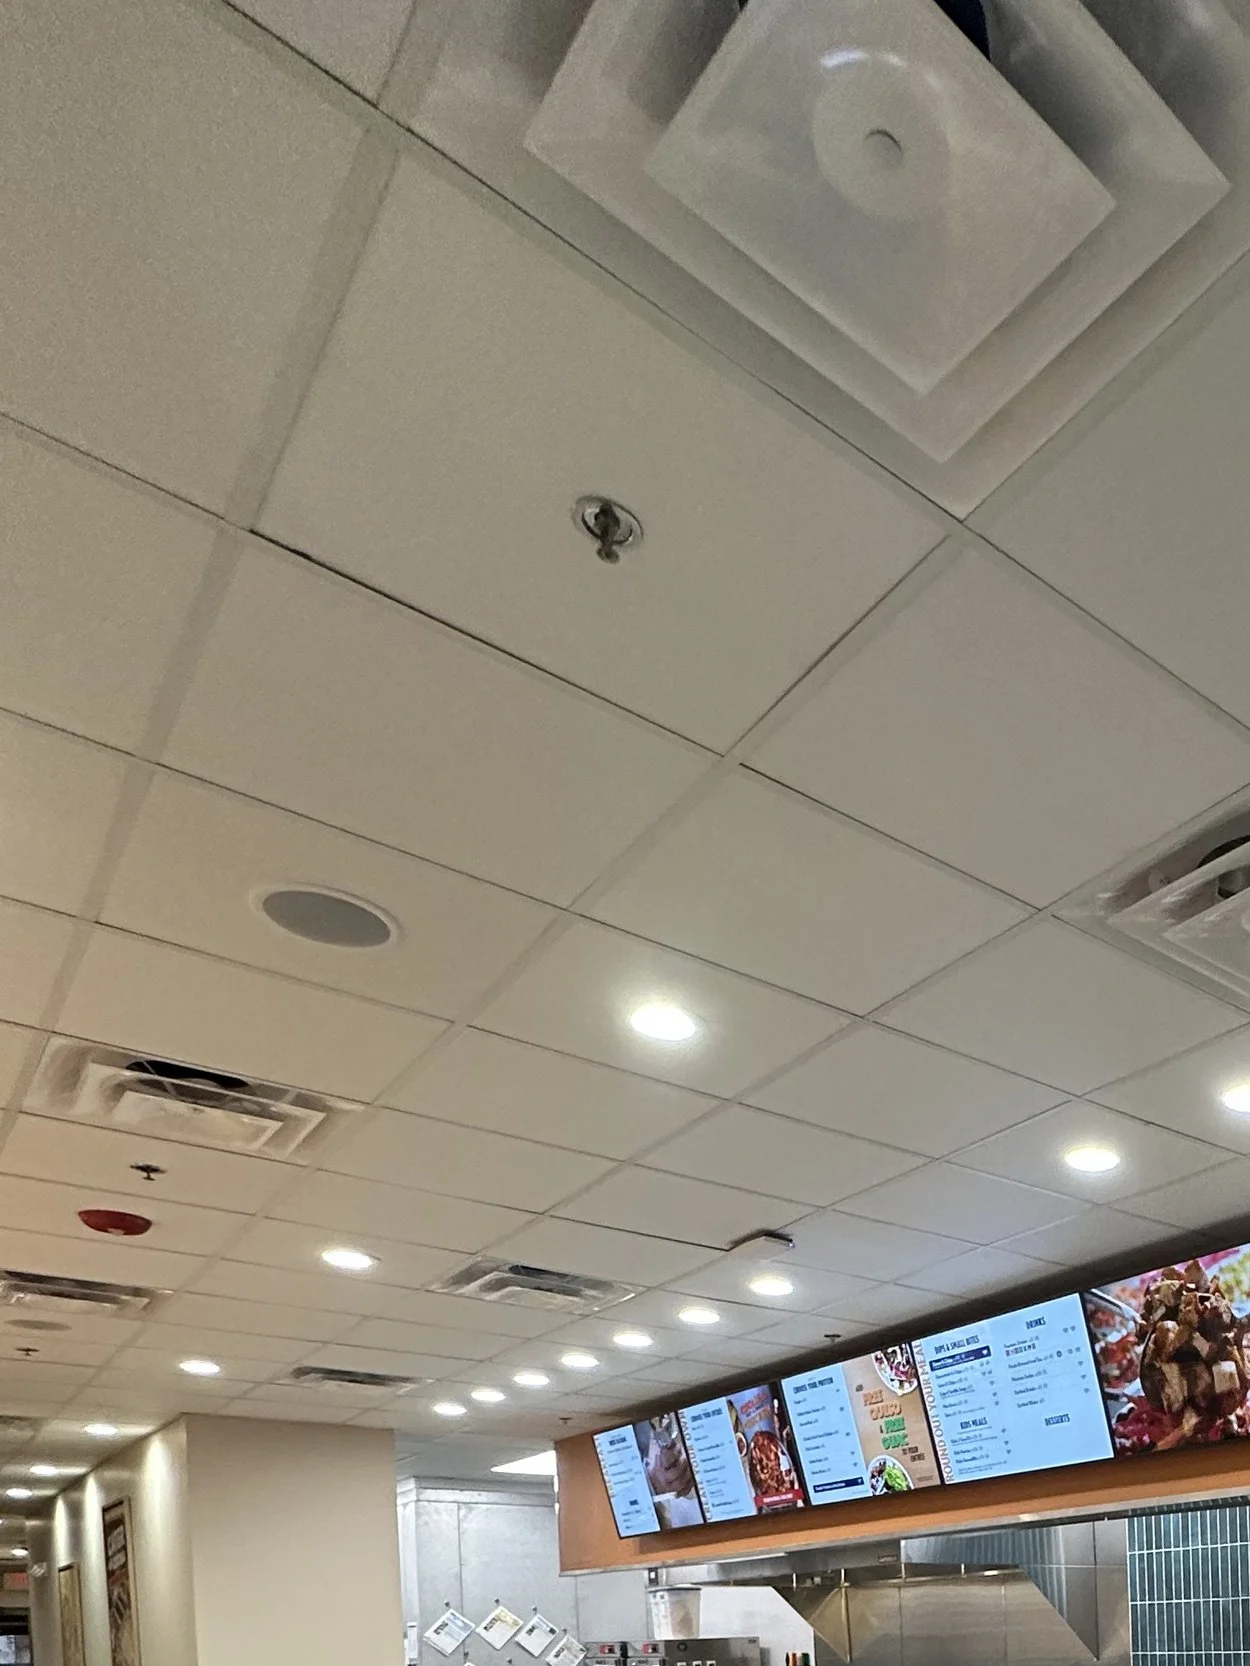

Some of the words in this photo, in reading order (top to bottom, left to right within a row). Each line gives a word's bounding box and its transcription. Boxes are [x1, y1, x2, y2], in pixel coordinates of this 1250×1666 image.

[923, 1378, 937, 1412] YOUR
[931, 1413, 944, 1439] OUT
[937, 1441, 954, 1482] ROUND
